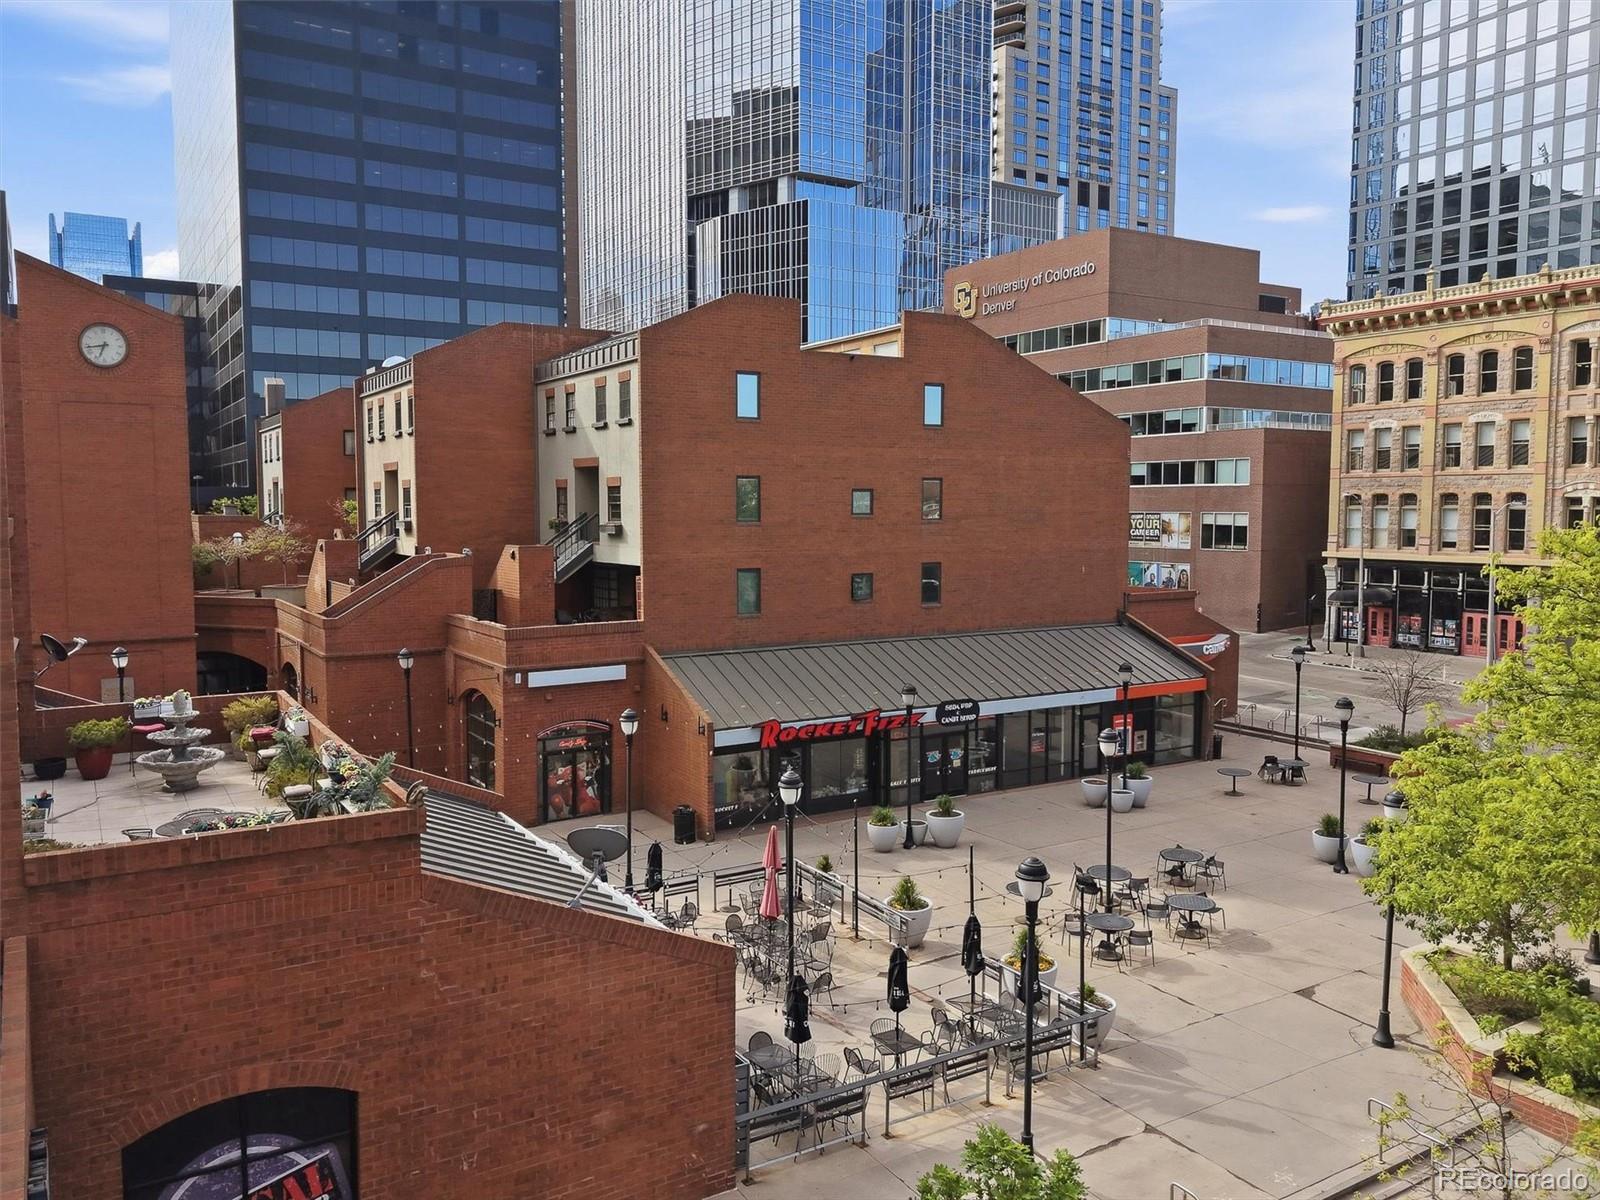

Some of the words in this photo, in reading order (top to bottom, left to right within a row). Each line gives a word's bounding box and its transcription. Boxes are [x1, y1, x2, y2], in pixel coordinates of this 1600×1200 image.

[982, 276, 1031, 298] University
[1031, 271, 1043, 286] of
[1045, 261, 1096, 283] Colorado
[982, 299, 1017, 316] Denver
[1130, 519, 1160, 529] YOUR
